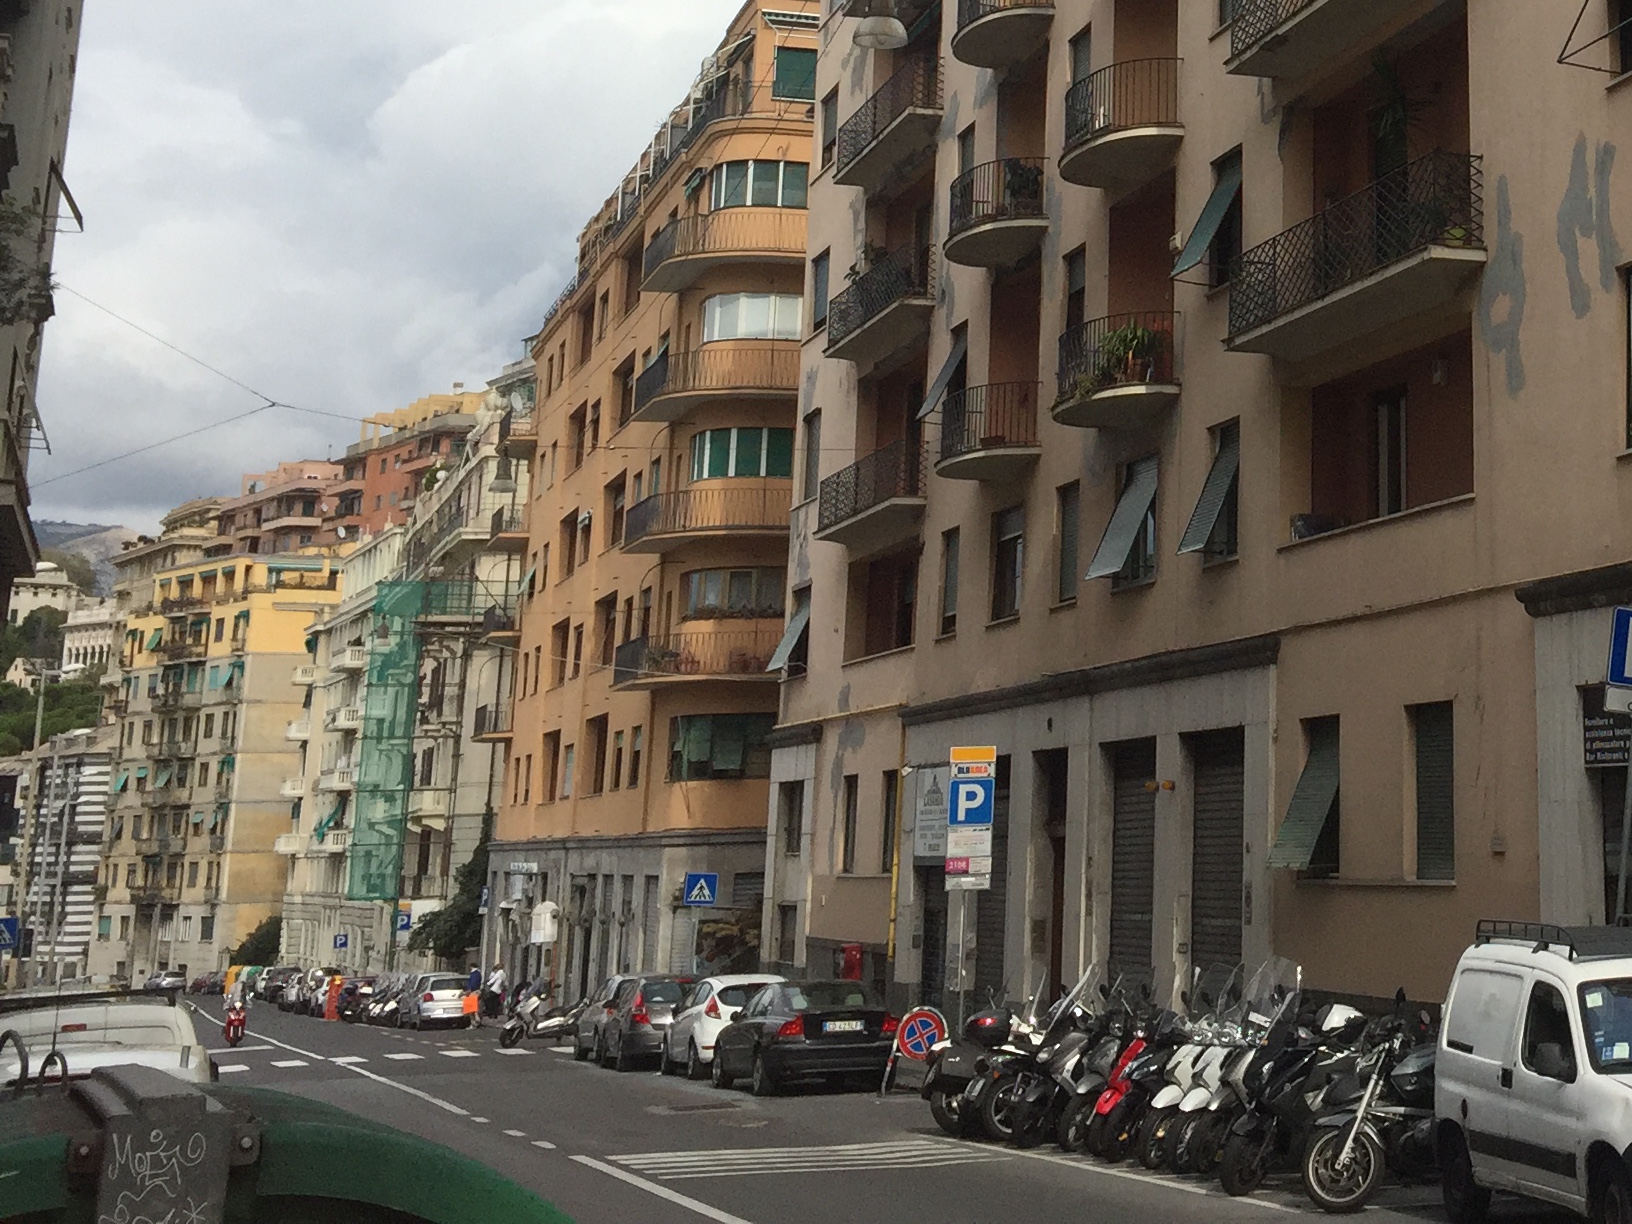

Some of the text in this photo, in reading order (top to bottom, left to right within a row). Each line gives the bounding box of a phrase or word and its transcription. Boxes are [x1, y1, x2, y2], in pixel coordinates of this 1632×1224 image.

[957, 783, 985, 822] P
[399, 915, 409, 927] P
[336, 935, 346, 948] P
